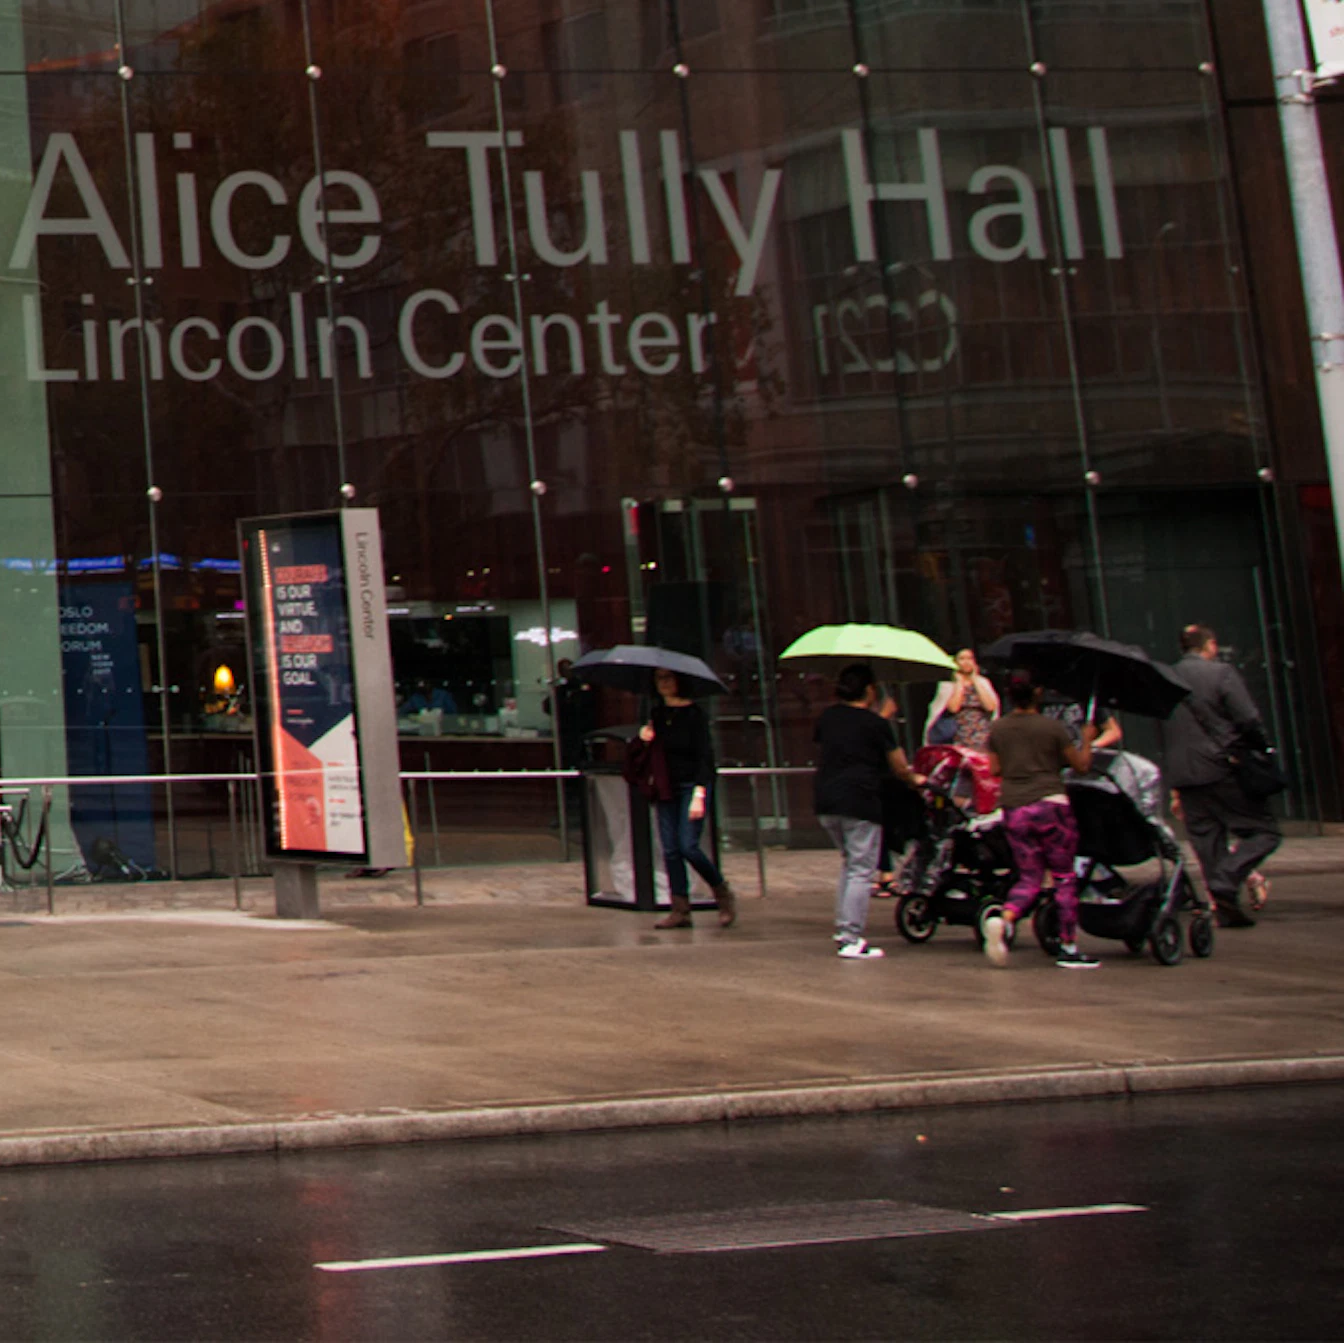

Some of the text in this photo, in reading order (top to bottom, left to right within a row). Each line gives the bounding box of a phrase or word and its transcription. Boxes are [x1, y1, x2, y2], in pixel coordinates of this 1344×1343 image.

[9, 126, 1124, 297] Alice Tully Hall
[21, 288, 718, 382] Lincoln Center
[287, 584, 312, 600] OUR
[356, 531, 375, 639] Lincoln Center
[279, 620, 303, 634] AND
[62, 640, 103, 652] ORUM
[292, 653, 317, 668] OUR
